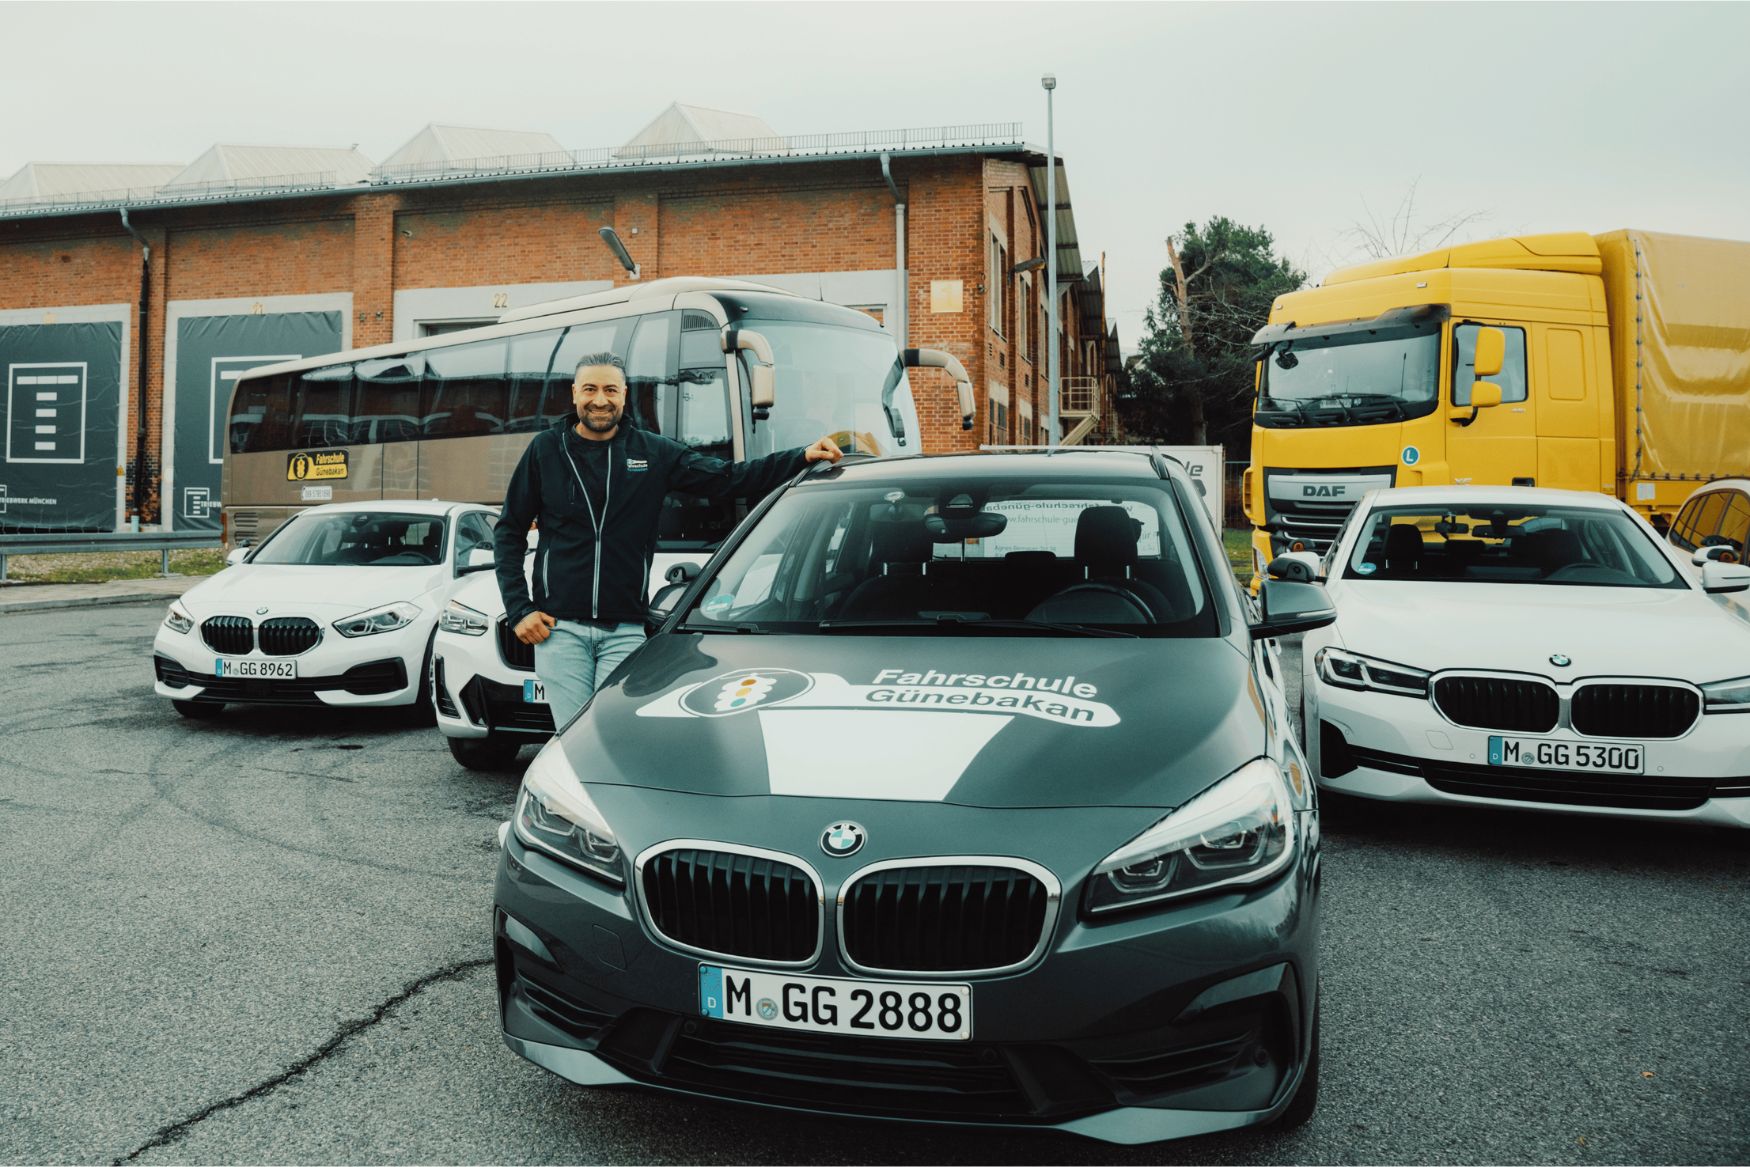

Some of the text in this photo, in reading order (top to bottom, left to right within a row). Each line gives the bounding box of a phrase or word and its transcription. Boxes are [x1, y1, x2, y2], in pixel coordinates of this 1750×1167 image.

[494, 293, 508, 308] 22
[1406, 449, 1414, 462] L
[1302, 485, 1346, 497] DAF
[223, 661, 232, 675] M
[240, 662, 257, 676] GG
[260, 662, 293, 677] 8962
[534, 682, 545, 700] M
[872, 668, 1098, 699] Fahrschule
[865, 688, 1095, 723] Günebakan
[1504, 740, 1519, 763] M
[1537, 743, 1570, 766] GG
[1576, 745, 1639, 770] 5300
[707, 975, 962, 1033] D M GG 2888
